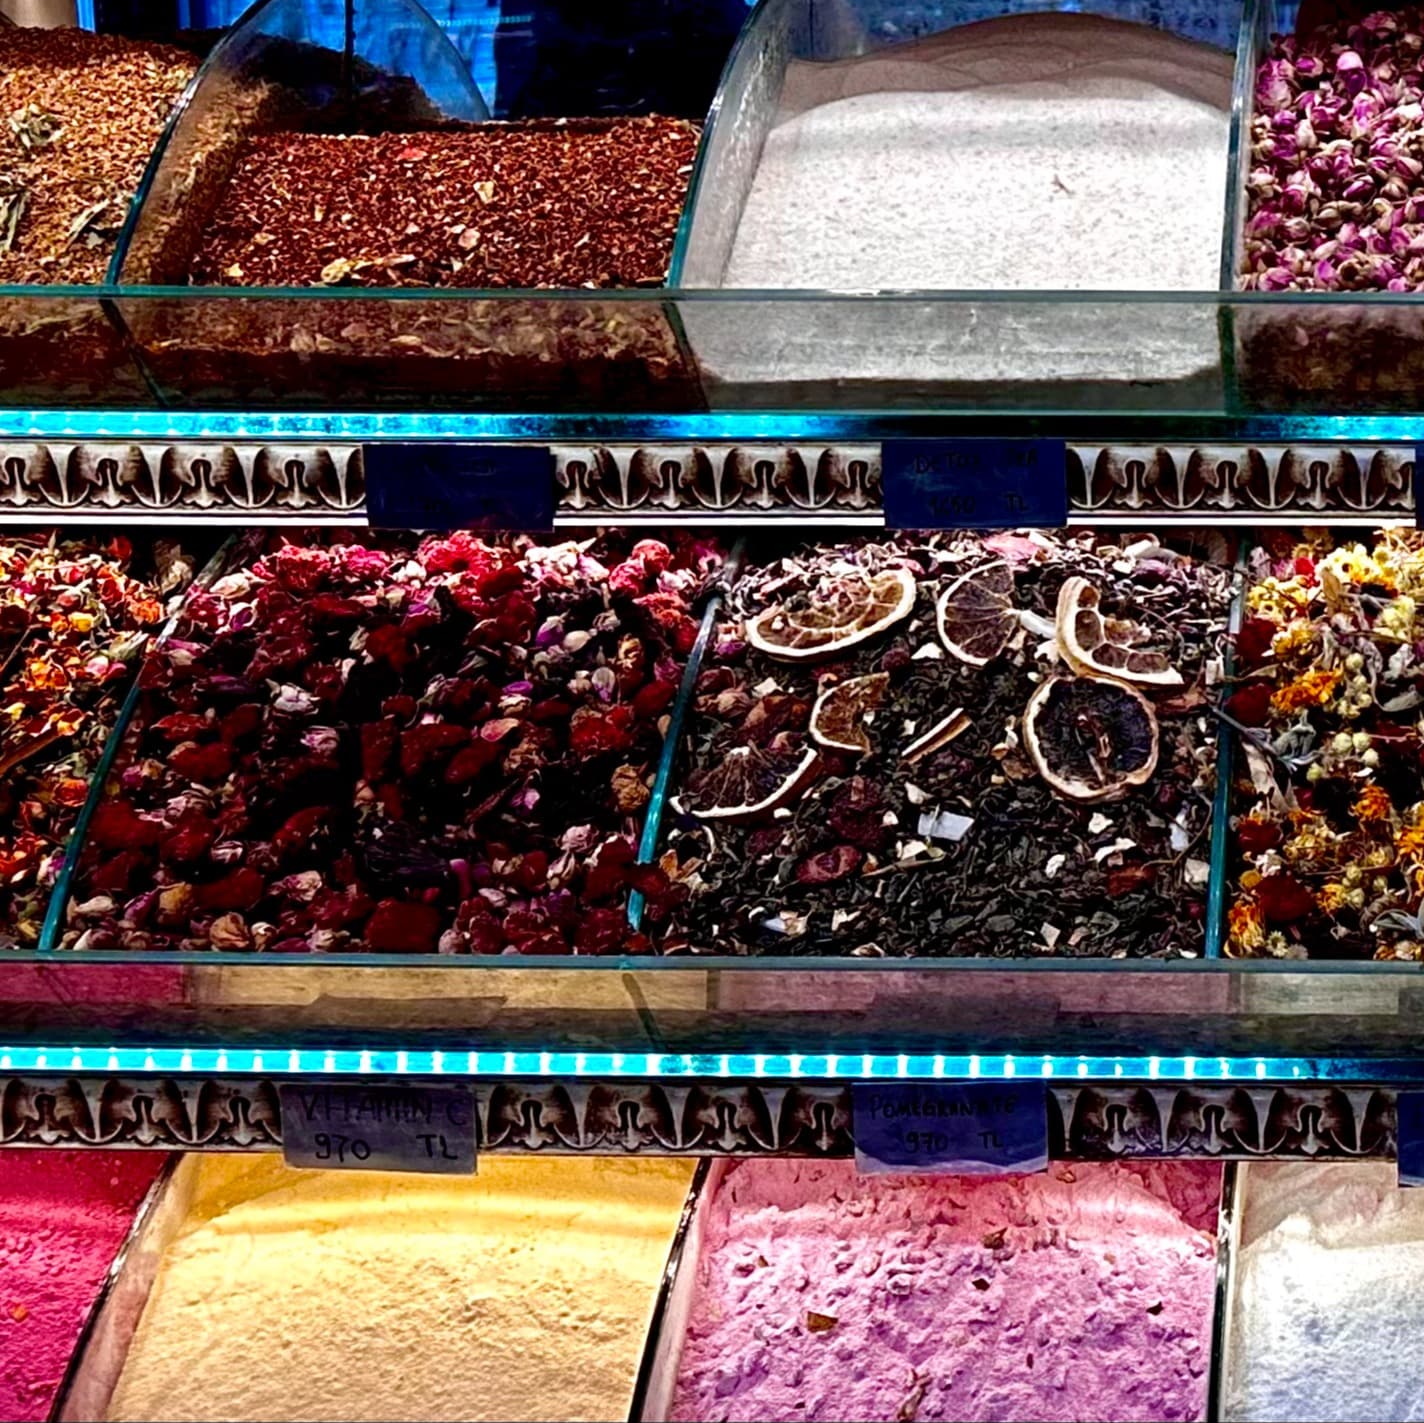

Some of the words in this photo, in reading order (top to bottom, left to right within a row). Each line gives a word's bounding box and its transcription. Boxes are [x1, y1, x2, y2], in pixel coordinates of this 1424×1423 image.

[446, 1098, 467, 1126] C
[314, 1132, 371, 1162] 970
[416, 1134, 459, 1160] TL
[904, 1131, 949, 1155] 970
[978, 1131, 1004, 1150] TL
